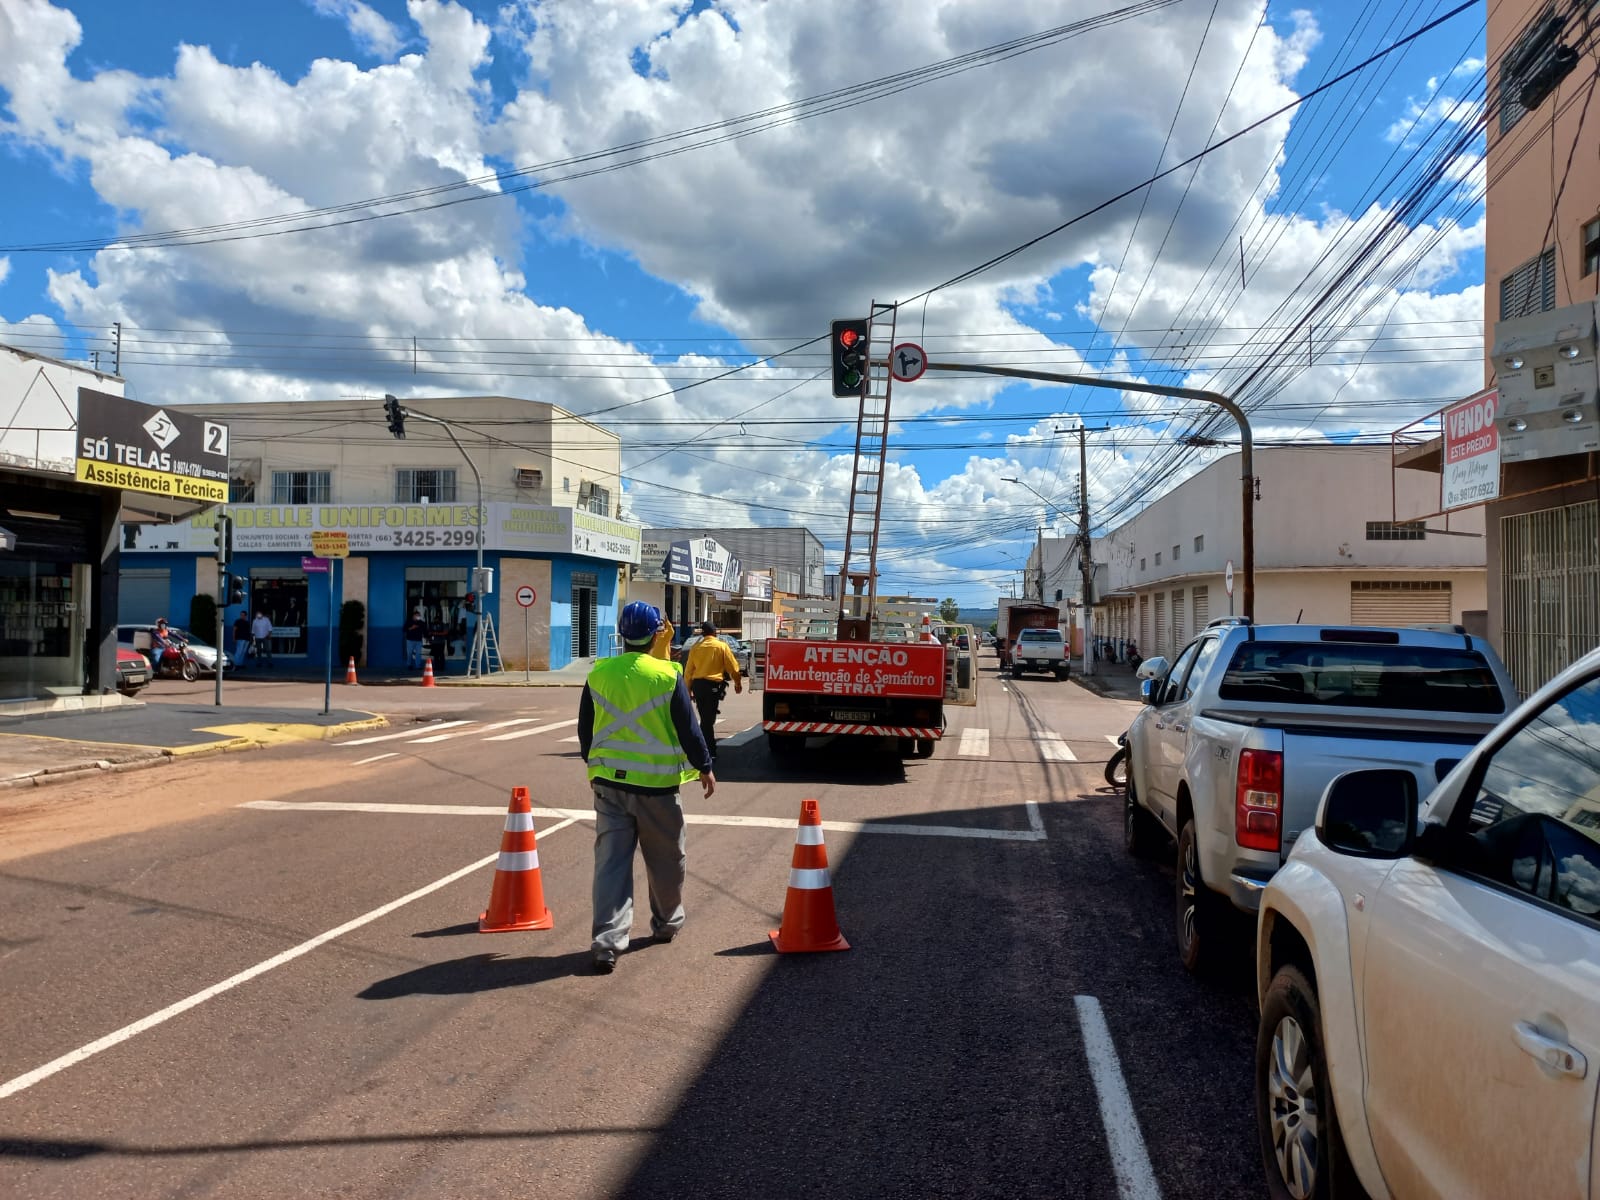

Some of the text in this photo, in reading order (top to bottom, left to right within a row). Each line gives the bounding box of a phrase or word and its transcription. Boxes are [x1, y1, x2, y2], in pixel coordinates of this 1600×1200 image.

[1450, 399, 1495, 440] VENDO
[208, 426, 222, 453] 2
[1450, 434, 1492, 459] ESTE PRÉDIO
[82, 436, 171, 471] SÓ TELAS
[84, 463, 224, 499] Assistência Técnica
[319, 505, 488, 528] UNIFORMES
[393, 530, 485, 547] 3425-2996
[705, 539, 717, 553] CASA
[803, 646, 908, 667] ATENÇÃO
[768, 664, 935, 686] Manutenção de Semáforo
[822, 682, 886, 694] SETRAT
